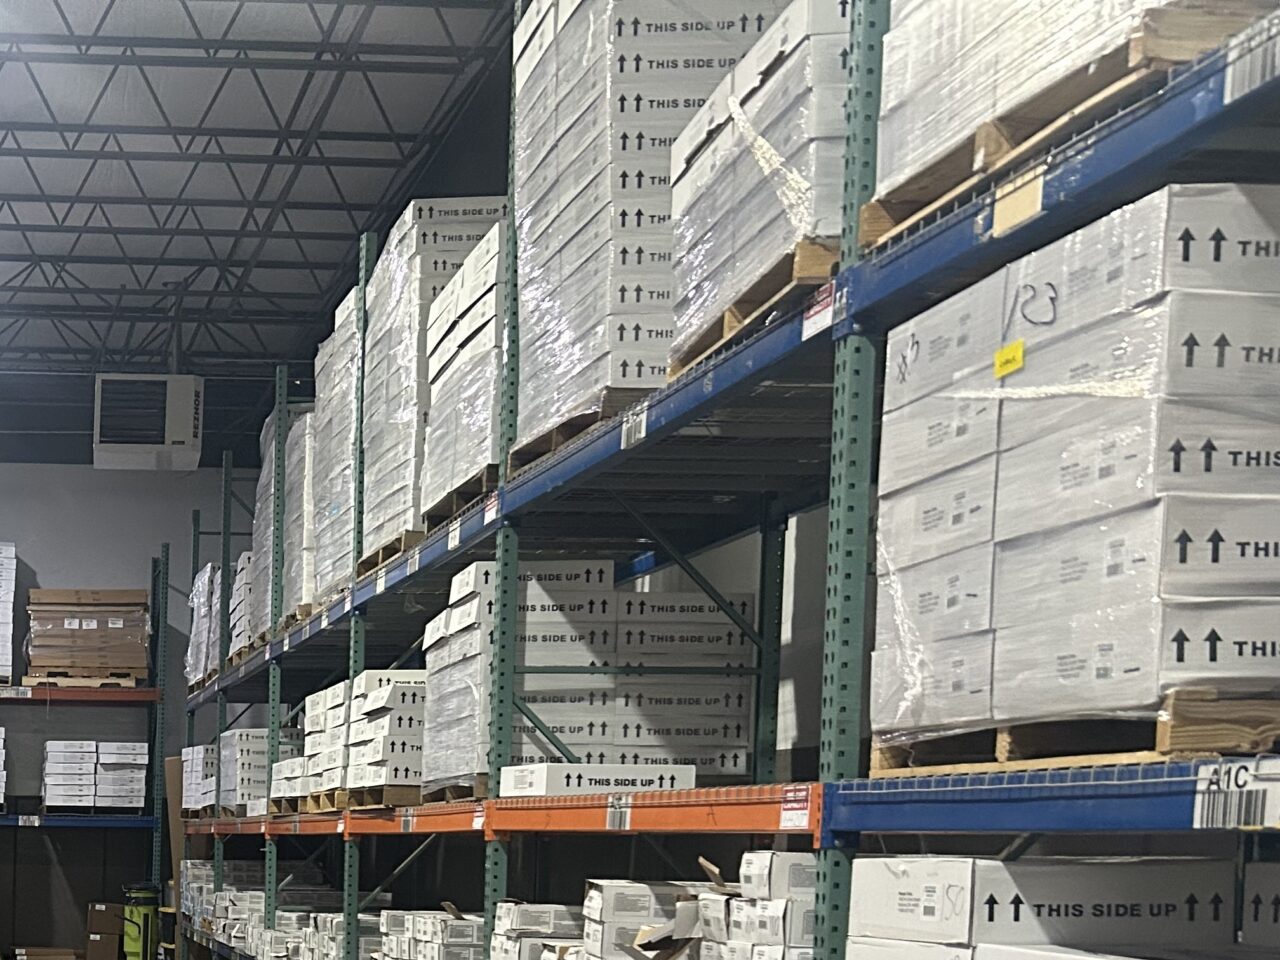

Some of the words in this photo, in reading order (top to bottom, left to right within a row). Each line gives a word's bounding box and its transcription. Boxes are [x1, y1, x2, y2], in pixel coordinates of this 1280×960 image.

[646, 23, 677, 33] THIS
[681, 22, 712, 32] SIDE
[717, 21, 735, 31] UP
[648, 60, 678, 69] THIS
[683, 59, 713, 68] SIDE
[718, 58, 736, 68] UP
[649, 100, 678, 109] THIS
[683, 99, 708, 108] SID
[438, 209, 459, 217] THIS
[486, 208, 499, 216] UP
[442, 234, 463, 242] THIS
[1238, 240, 1280, 257] THI
[648, 290, 670, 300] THI
[193, 390, 201, 439] REZNOR
[1236, 541, 1279, 557] THI
[518, 604, 536, 612] HIS
[540, 604, 566, 612] SIDE
[569, 604, 584, 612] UP
[650, 605, 676, 613] THIS
[679, 605, 704, 613] SIDE
[650, 635, 675, 643] THIS
[678, 635, 704, 643] SIDE
[707, 635, 722, 643] UP
[1233, 641, 1280, 657] THI
[520, 695, 540, 703] HIS
[541, 695, 566, 703] SIDE
[512, 725, 536, 733] THIS
[646, 728, 671, 736] THIS
[674, 728, 701, 736] SIDE
[704, 728, 718, 736] UP
[511, 755, 535, 763] THIS
[538, 755, 563, 763] SIDE
[644, 757, 669, 765] THIS
[672, 757, 697, 765] SIDE
[700, 757, 715, 765] UP
[588, 778, 610, 786] THIS
[613, 778, 637, 786] SIDE
[640, 778, 655, 786] UP
[1207, 765, 1248, 790] A1C
[1034, 904, 1084, 918] THIS
[1091, 903, 1142, 917] SIDE
[1150, 903, 1178, 916] UP
